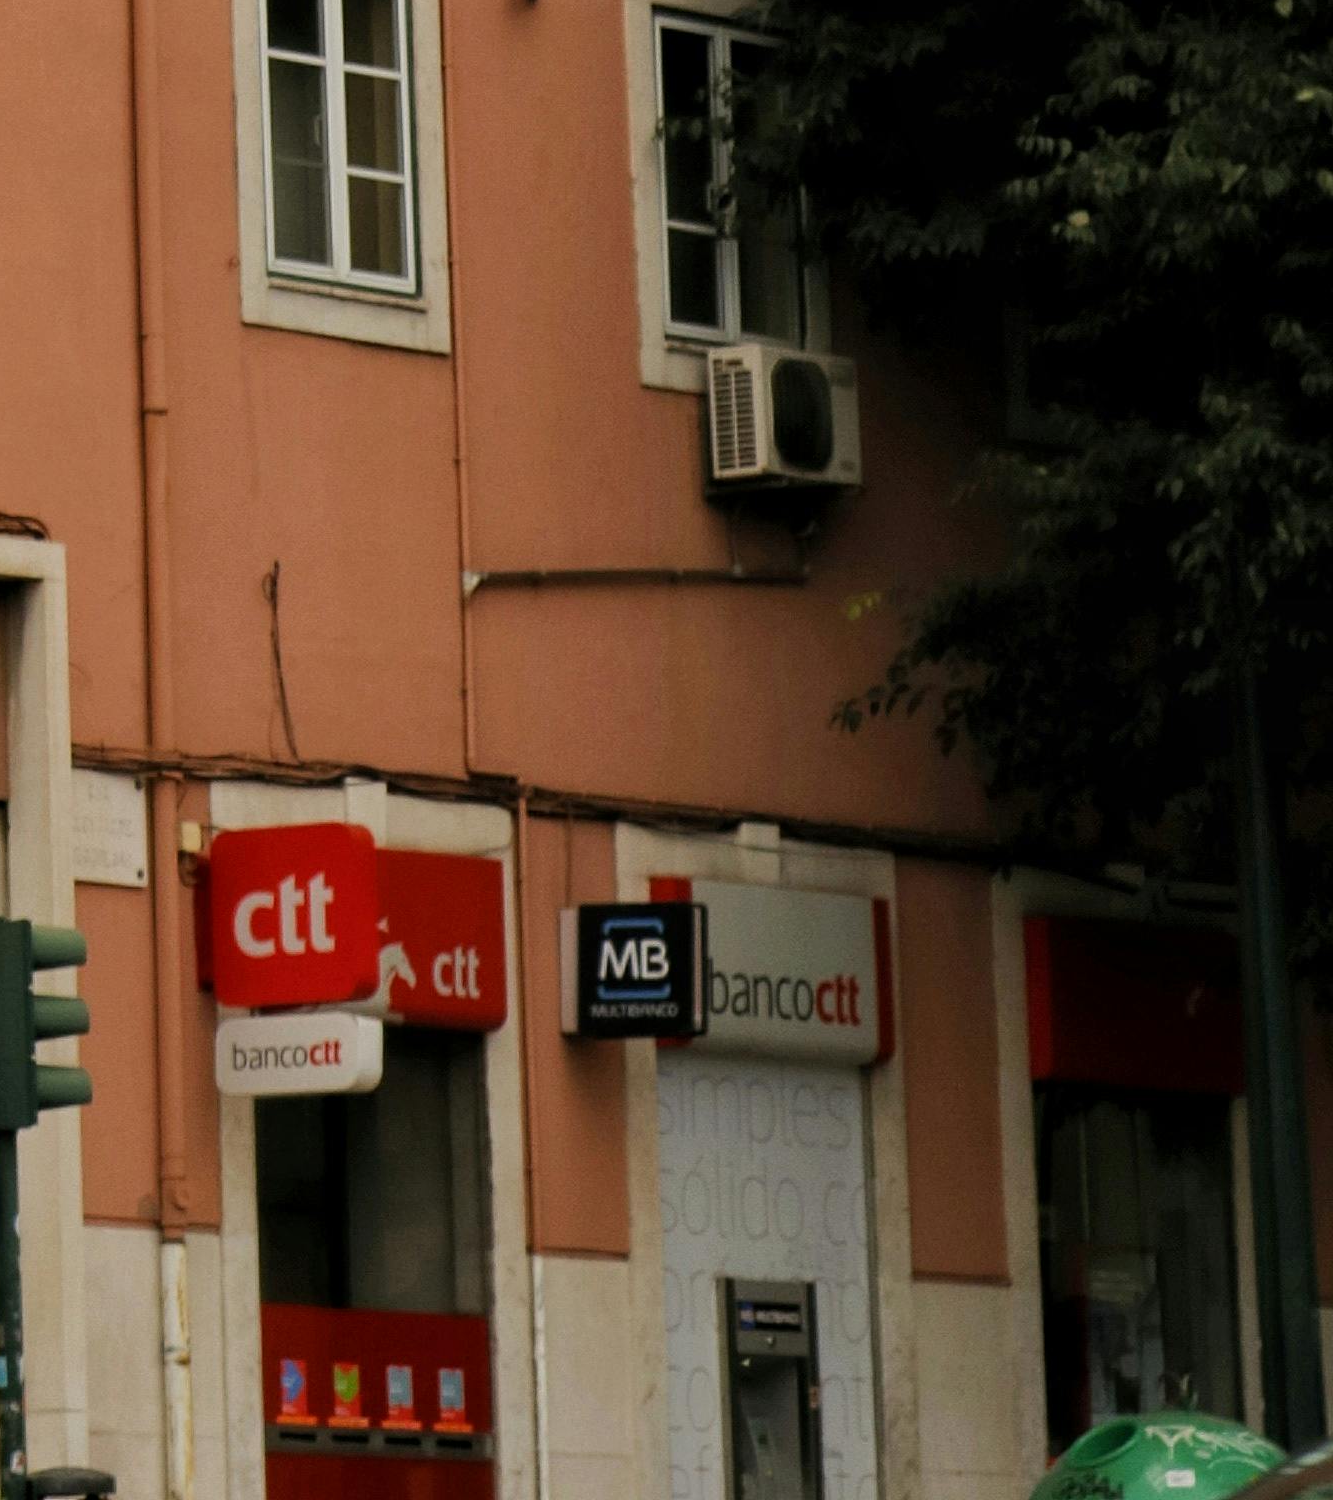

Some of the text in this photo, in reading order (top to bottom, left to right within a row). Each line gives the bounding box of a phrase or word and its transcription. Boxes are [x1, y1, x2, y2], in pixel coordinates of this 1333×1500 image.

[233, 871, 336, 960] ctt
[433, 946, 482, 1000] ctt
[597, 938, 670, 984] MB
[707, 956, 862, 1028] bancoctt
[232, 1038, 343, 1073] bancoctt
